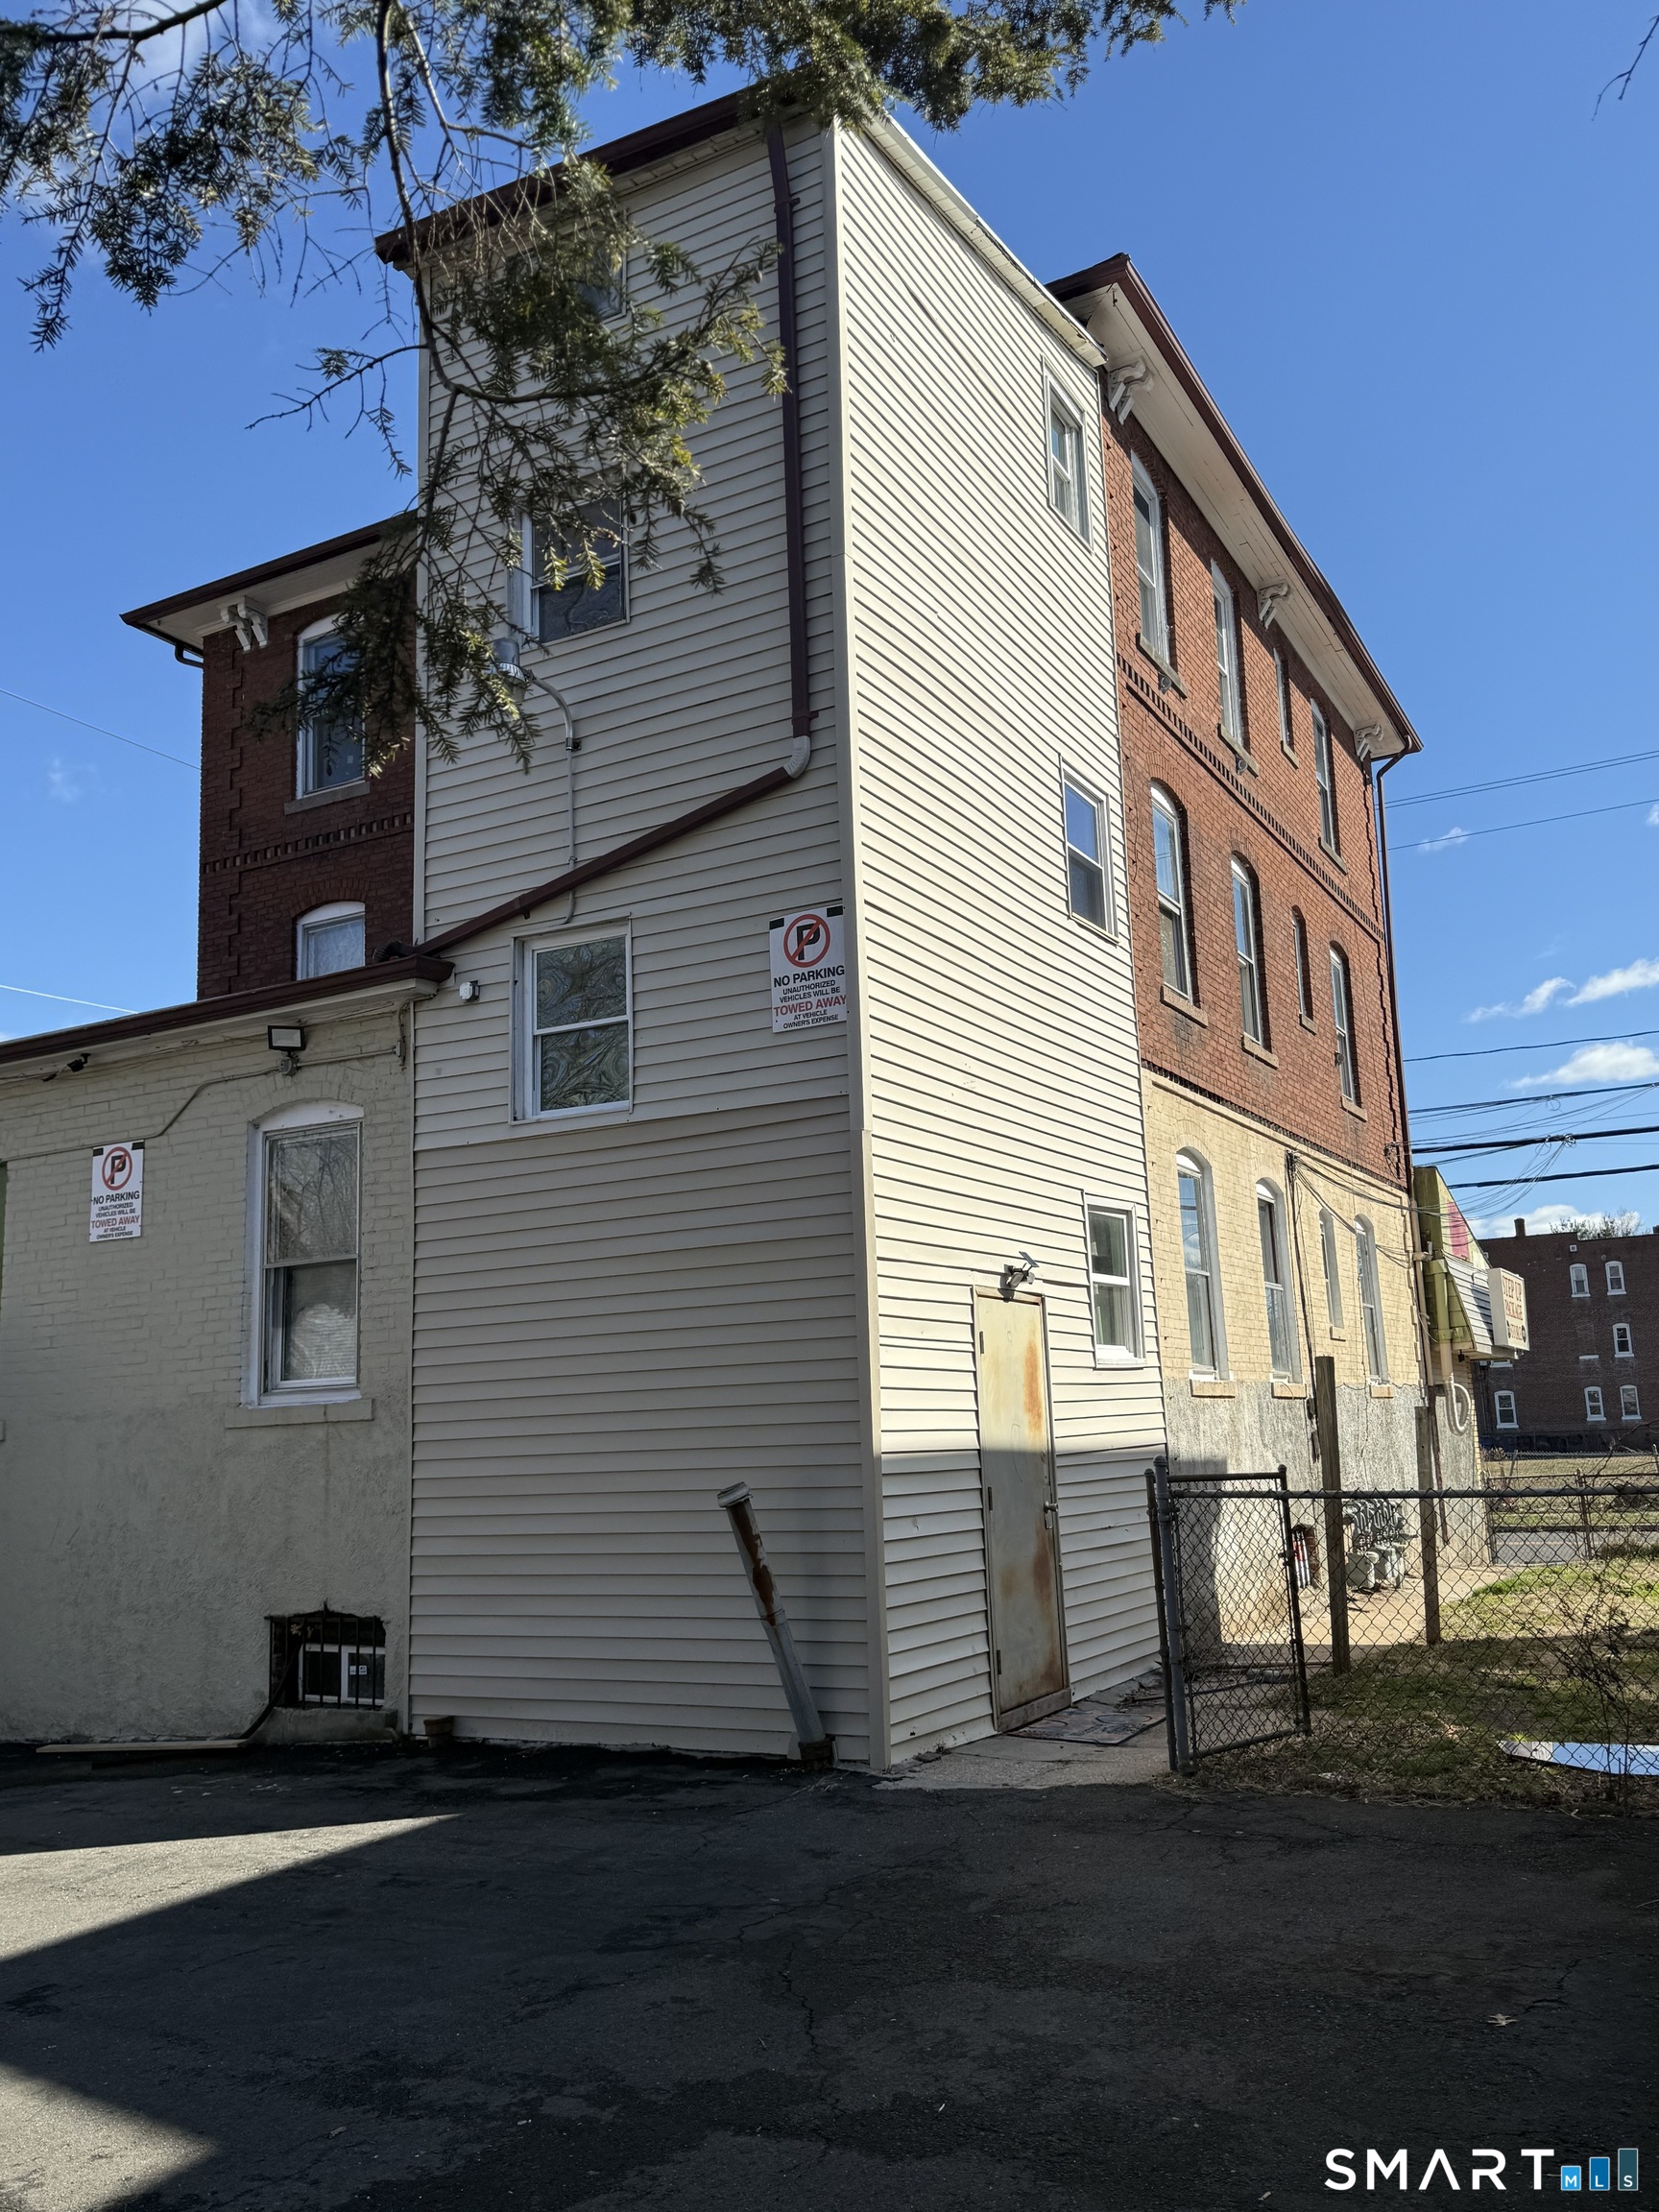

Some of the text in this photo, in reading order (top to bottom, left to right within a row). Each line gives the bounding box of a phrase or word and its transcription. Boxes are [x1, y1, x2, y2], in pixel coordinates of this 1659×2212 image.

[773, 965, 845, 988] NO PARKING
[782, 979, 836, 995] UNAUTHORIZED
[779, 992, 812, 1003] VEHICLES
[813, 989, 830, 998] WILL
[773, 995, 847, 1017] TOWED AWAY
[782, 1014, 839, 1029] OWNER'S EXPENSE
[802, 1009, 828, 1019] VEHICLE
[92, 1190, 140, 1206] NO PARKING
[95, 1210, 117, 1218] VEHICLES
[98, 1202, 133, 1212] UNAUTHORIZED
[91, 1214, 140, 1229] TOWED AWAY
